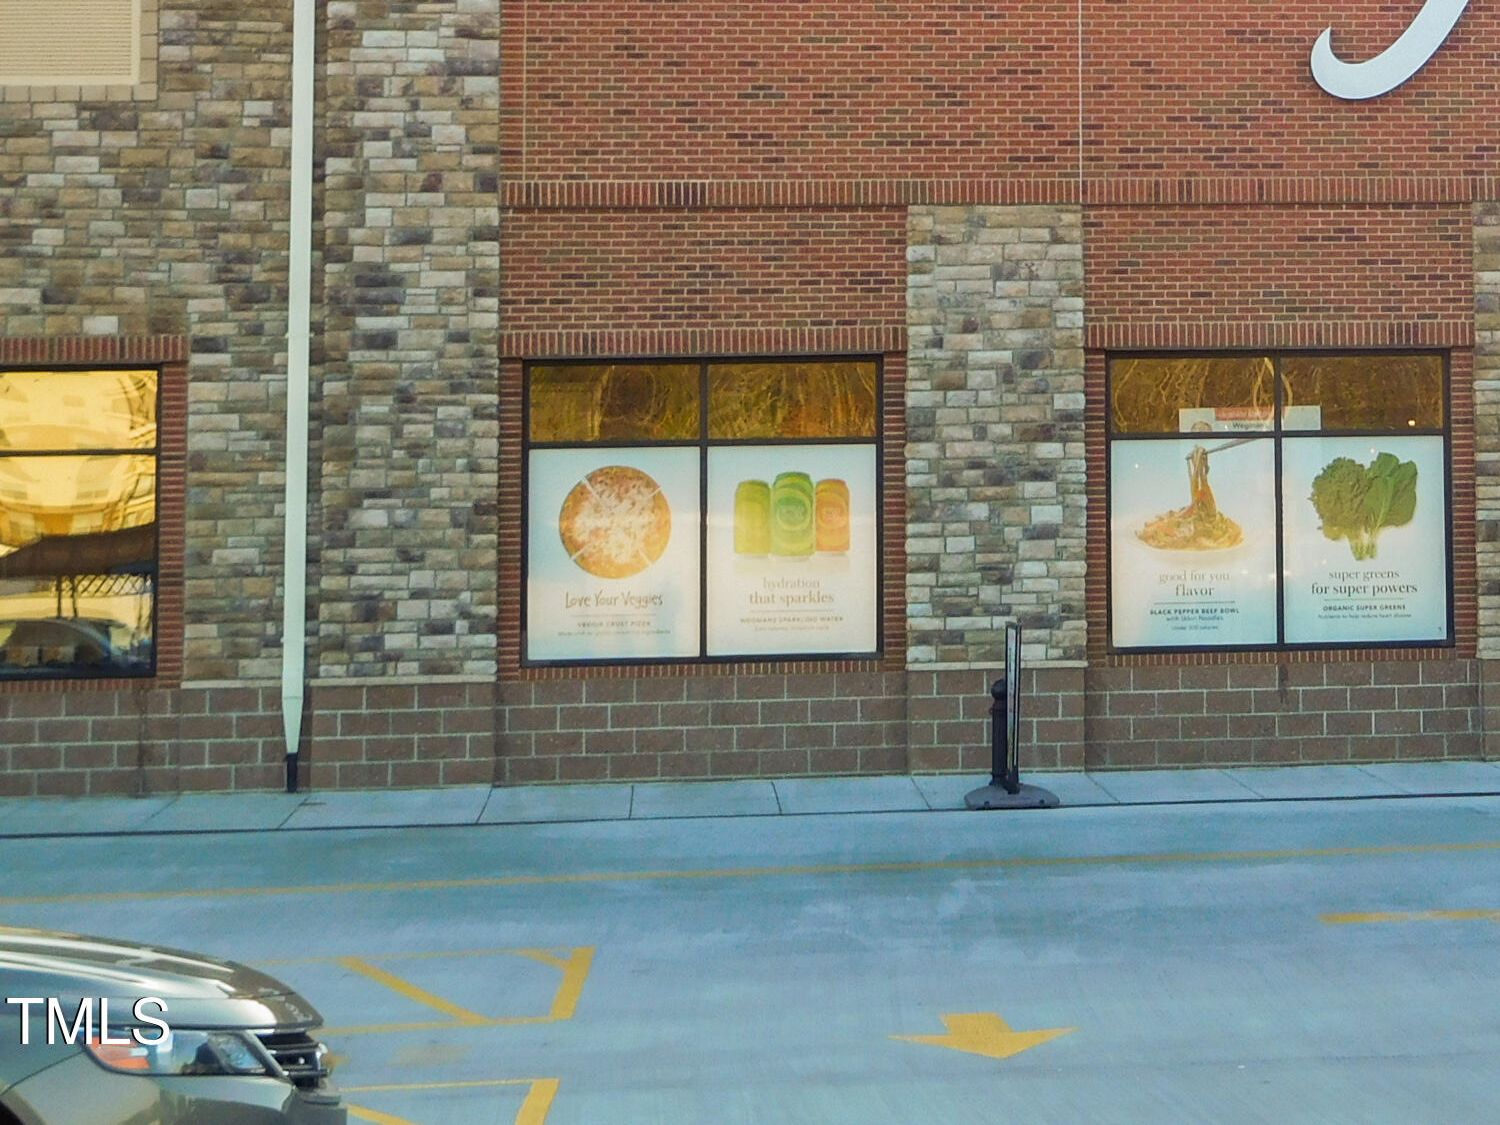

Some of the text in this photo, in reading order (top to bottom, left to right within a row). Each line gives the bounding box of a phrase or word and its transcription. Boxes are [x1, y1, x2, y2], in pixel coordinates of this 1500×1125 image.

[1159, 570, 1230, 585] good for you
[1328, 570, 1400, 582] super greens
[763, 577, 821, 591] hydration
[1175, 584, 1214, 596] flavor
[1311, 582, 1418, 597] for super powers
[565, 589, 663, 609] Love Your Veggies
[749, 590, 834, 607] that sparkles
